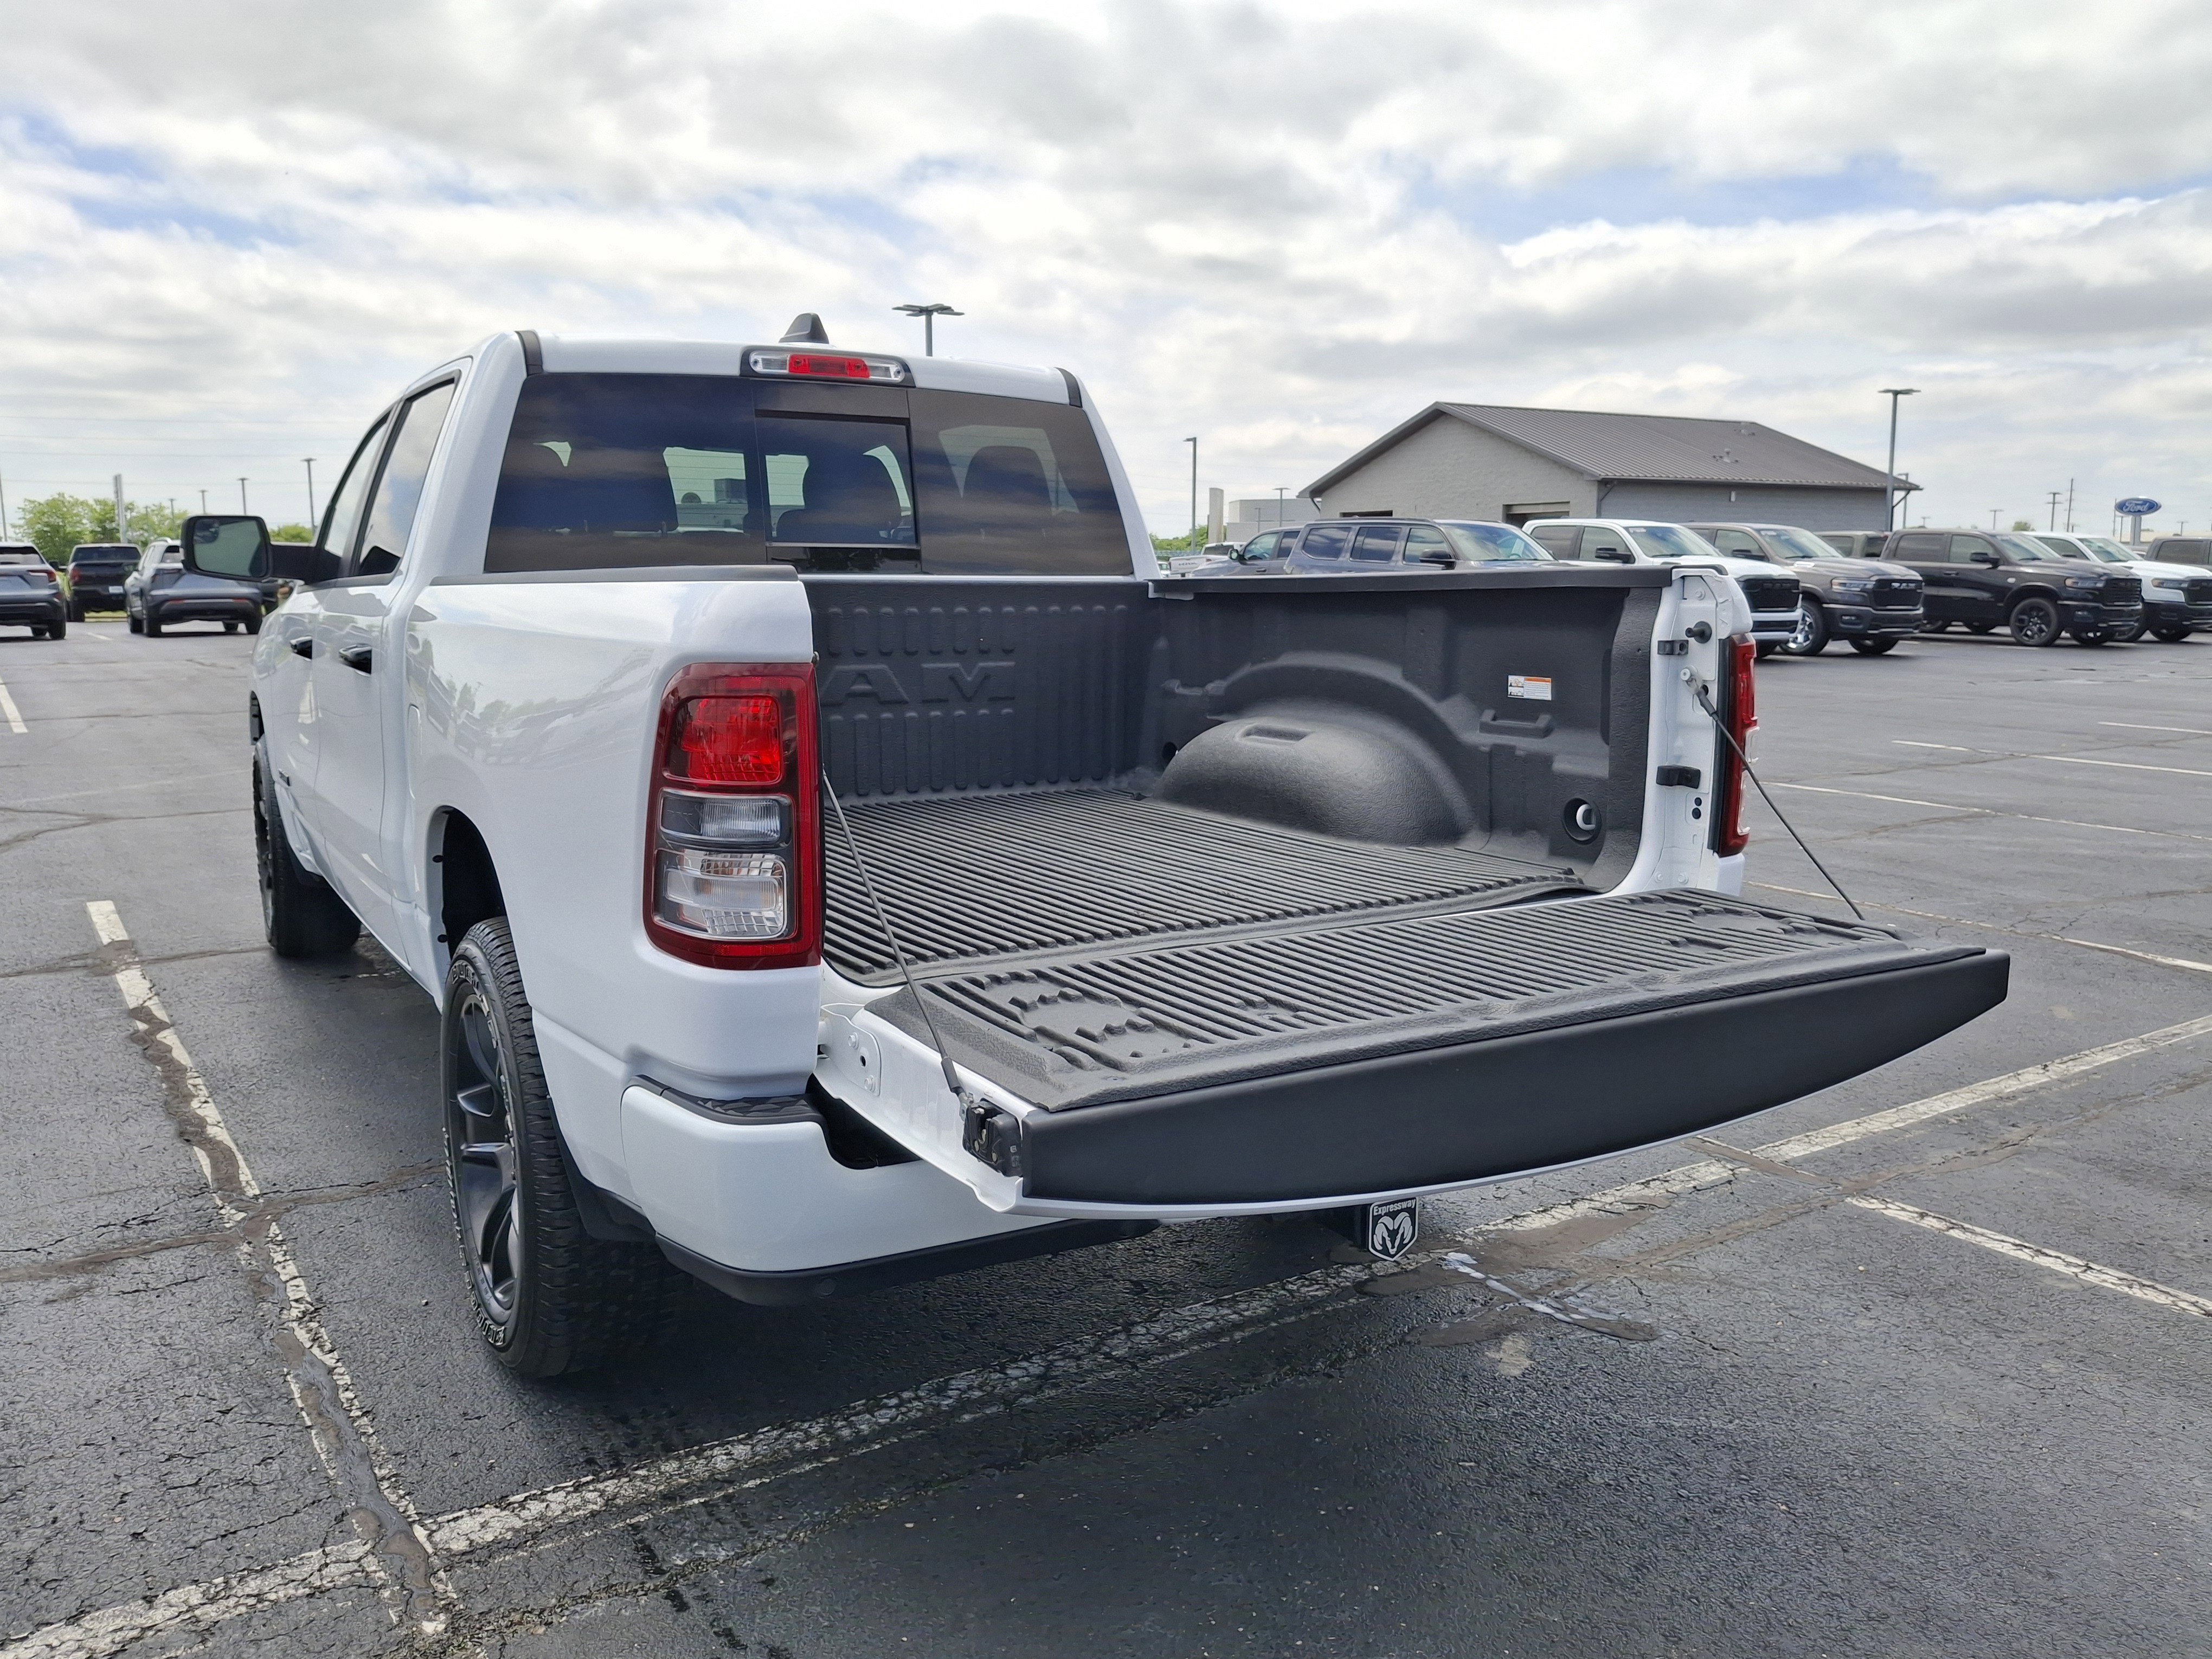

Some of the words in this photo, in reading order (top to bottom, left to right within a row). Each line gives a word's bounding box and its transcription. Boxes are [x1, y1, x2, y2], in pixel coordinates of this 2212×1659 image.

[2123, 500, 2149, 512] Ford
[821, 661, 1017, 707] AM
[1373, 1200, 1416, 1216] Expressway
